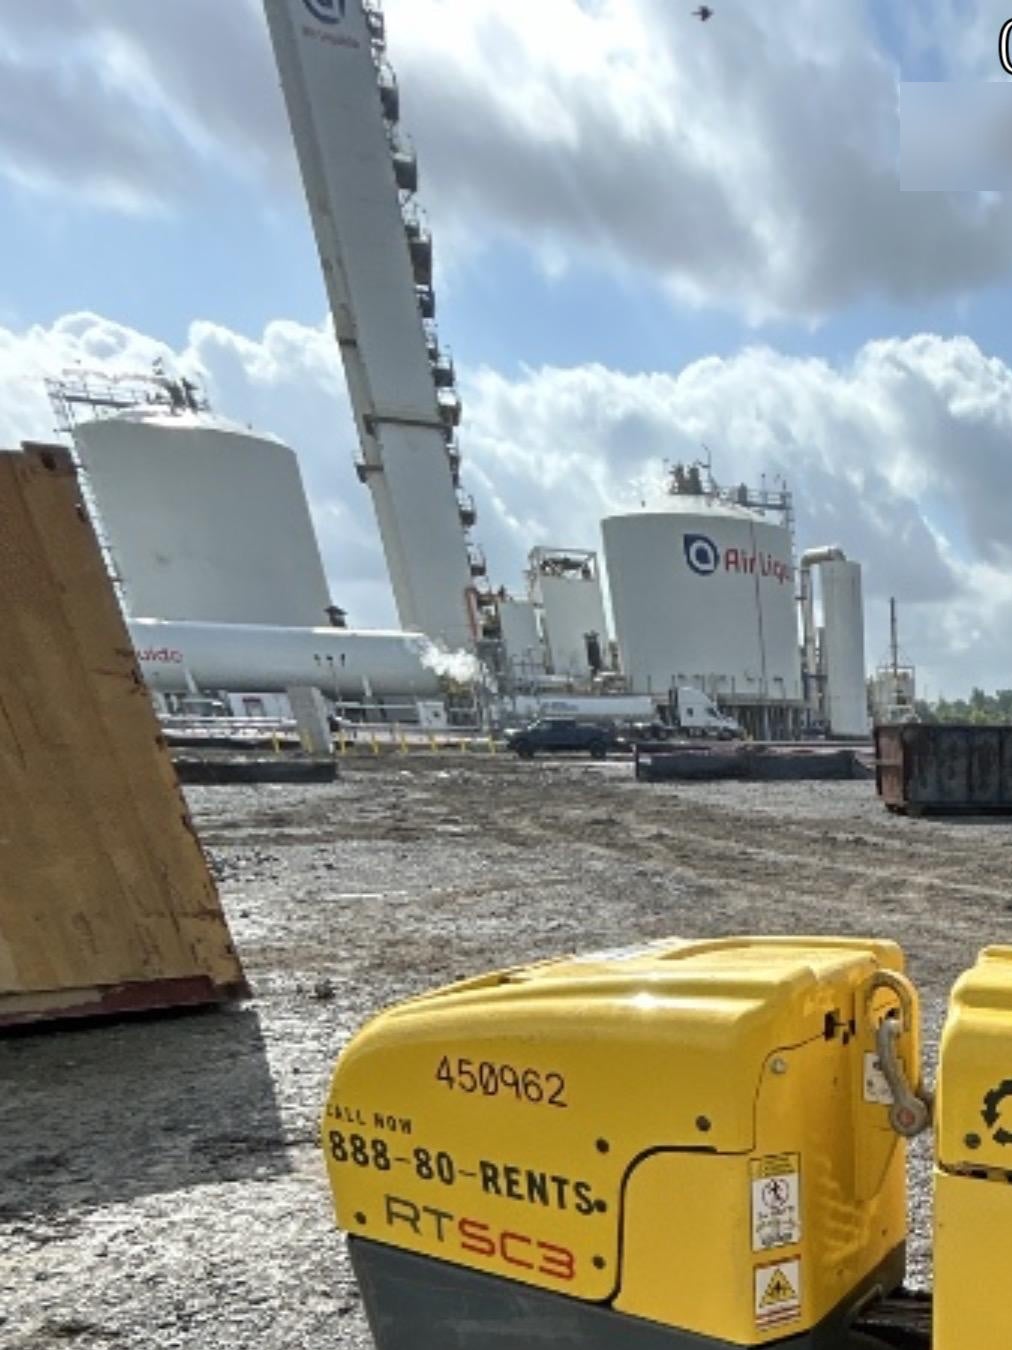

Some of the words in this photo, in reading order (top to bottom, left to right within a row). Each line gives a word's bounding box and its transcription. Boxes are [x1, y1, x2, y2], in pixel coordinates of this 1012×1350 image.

[436, 1056, 568, 1108] 450962
[326, 1102, 367, 1126] CALL
[373, 1111, 413, 1136] NOW
[328, 1130, 595, 1216] 888-80-RENTS
[384, 1193, 576, 1281] RTSC3
